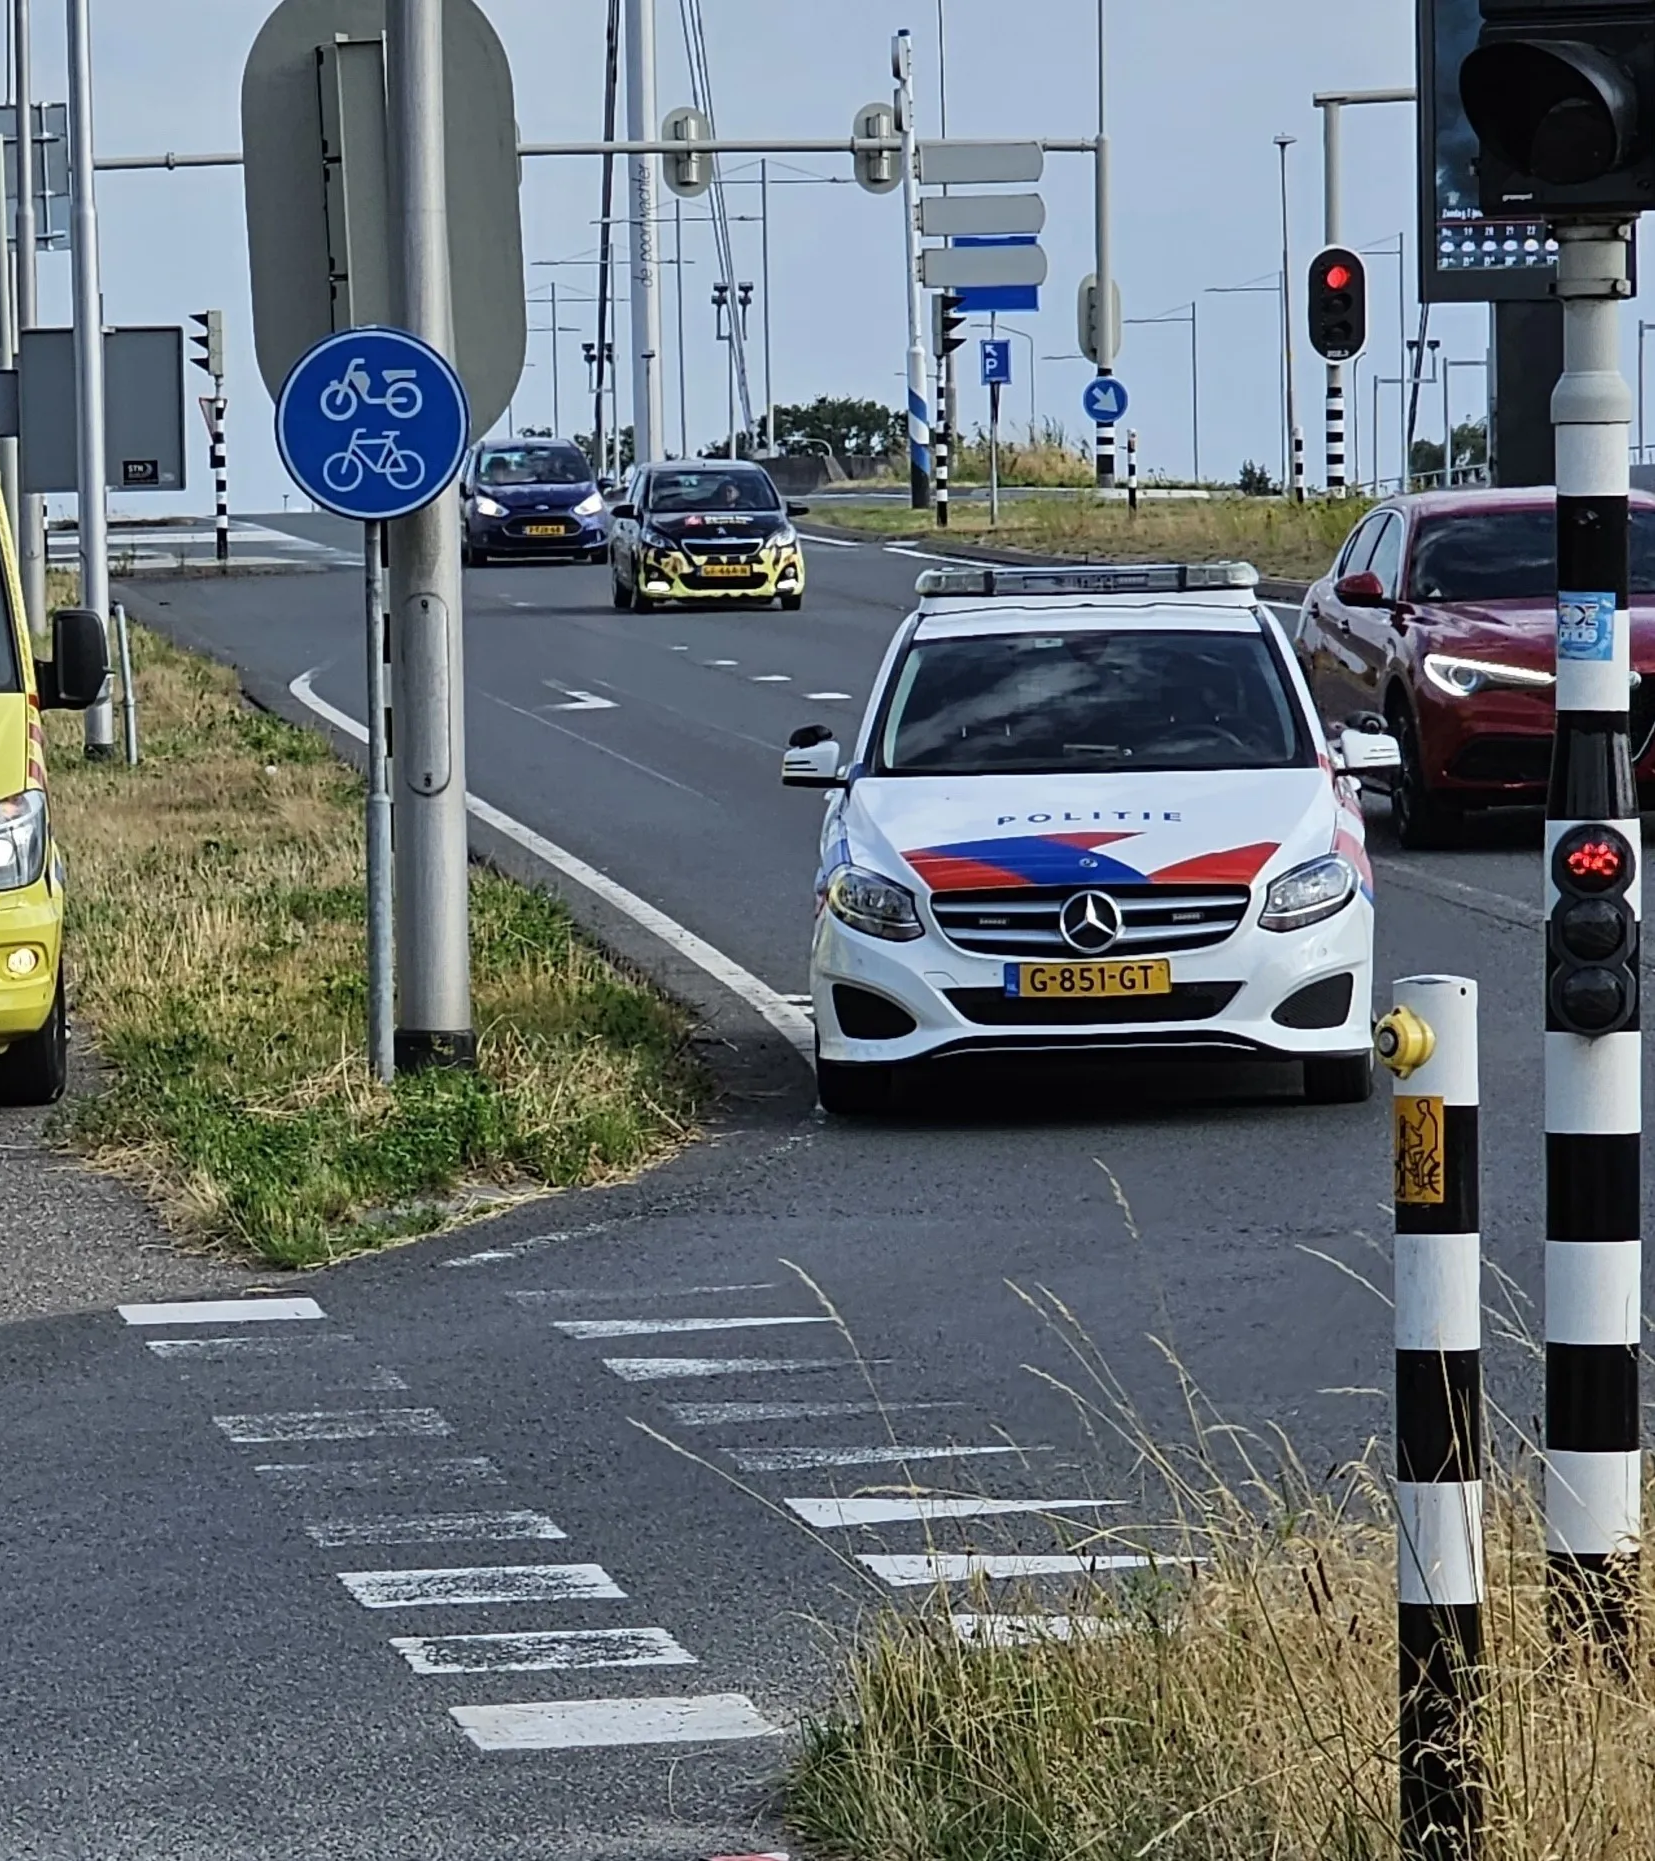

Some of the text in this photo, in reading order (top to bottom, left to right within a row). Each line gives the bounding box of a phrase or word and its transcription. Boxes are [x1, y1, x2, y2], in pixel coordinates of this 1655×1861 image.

[985, 358, 998, 375] P
[996, 811, 1182, 826] POLITIE
[1029, 965, 1154, 993] G-851-GT
